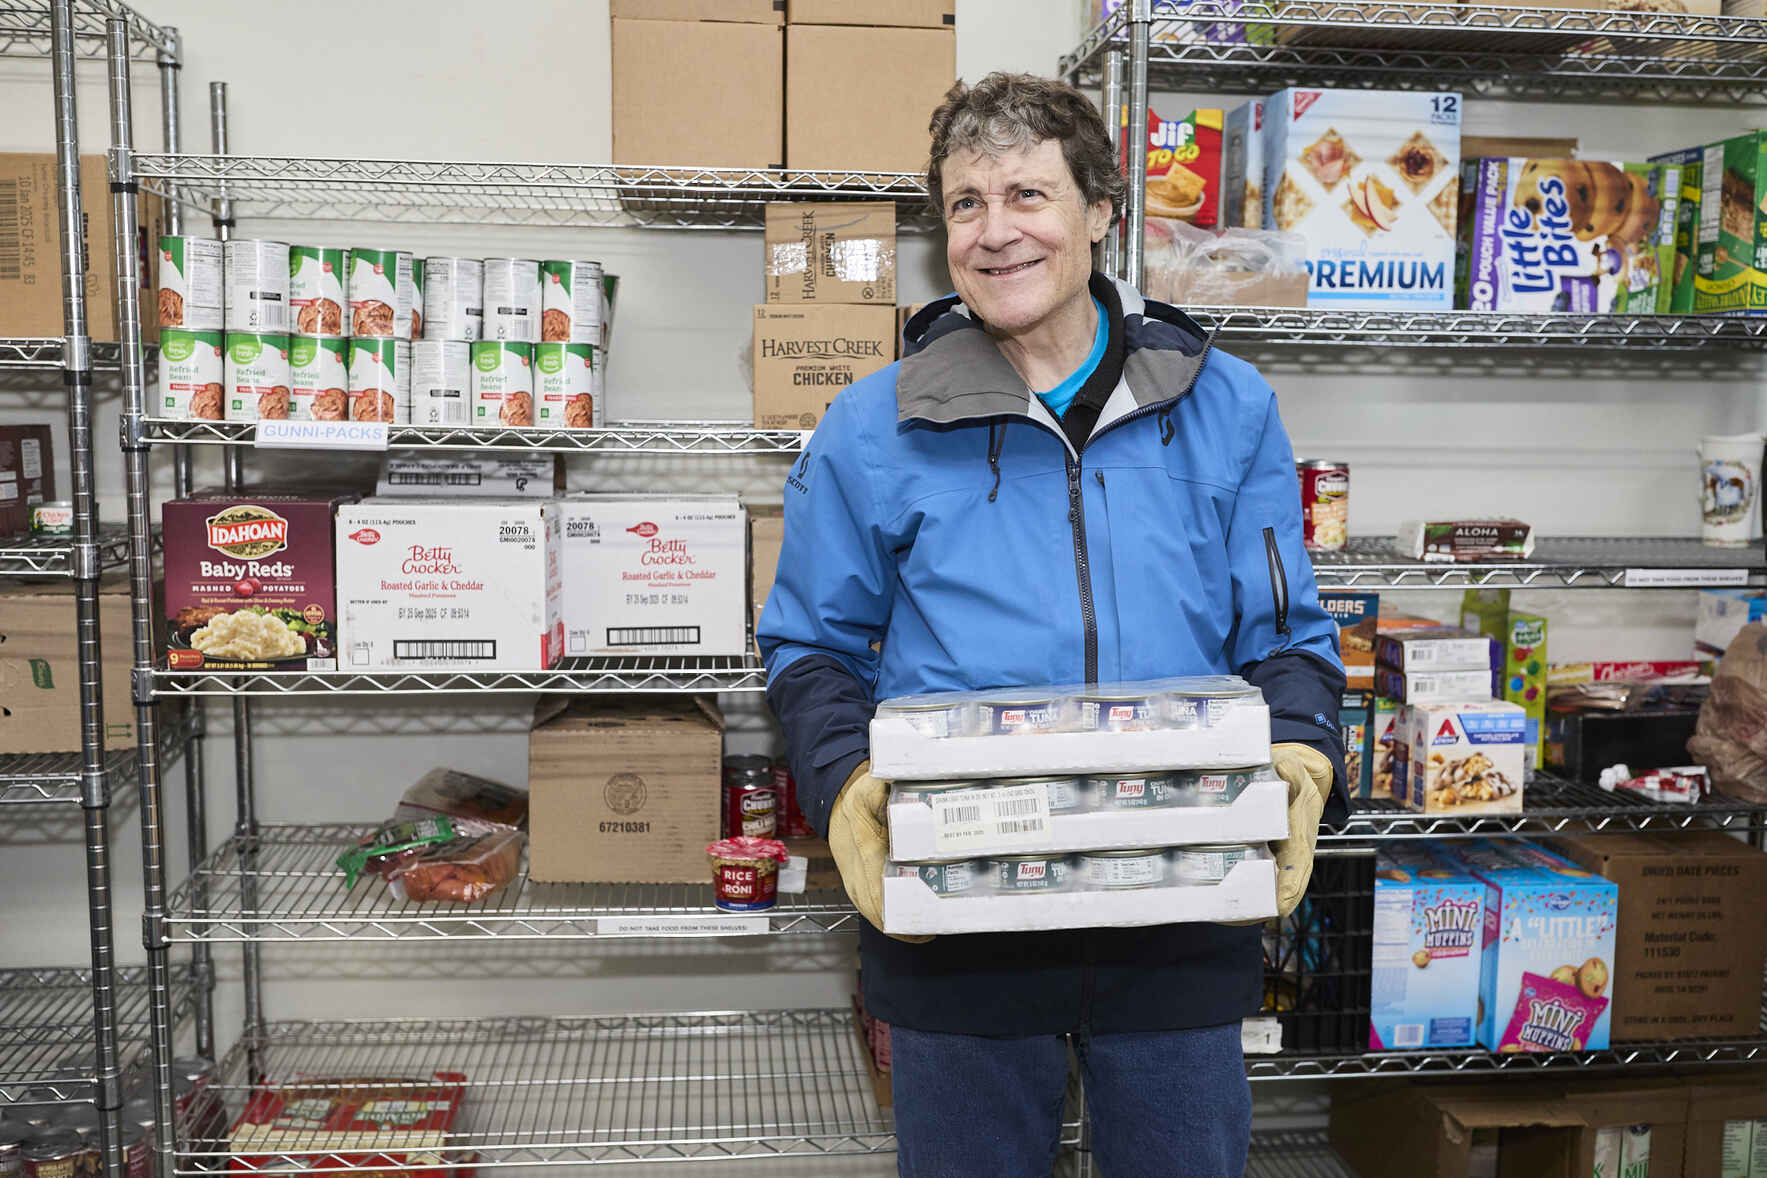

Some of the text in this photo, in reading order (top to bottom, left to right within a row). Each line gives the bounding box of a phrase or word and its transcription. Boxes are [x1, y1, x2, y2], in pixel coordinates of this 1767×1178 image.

[1431, 96, 1457, 113] 12
[1150, 122, 1194, 147] Jif
[1485, 162, 1500, 196] PACK
[20, 205, 33, 227] 2025
[1482, 197, 1496, 235] VALUE
[1540, 178, 1579, 267] Bites
[800, 210, 816, 248] CREEK
[1478, 238, 1493, 281] POUCH
[1503, 210, 1553, 293] Little
[762, 338, 884, 358] HARVEST CREEK
[793, 372, 853, 386] CHICKEN
[264, 424, 383, 440] GUNNI-PACKS
[787, 475, 808, 495] SCOTT
[212, 523, 283, 544] IDAHOAN
[499, 526, 529, 535] 20078
[566, 522, 594, 530] 20078
[1456, 528, 1498, 536] ALOHA
[646, 538, 687, 554] Betty
[408, 545, 452, 564] Betty
[641, 550, 695, 566] Crocker
[200, 561, 293, 581] Baby Reds
[401, 558, 463, 574] Crocker
[622, 570, 716, 581] Roasted Garlic & Cheddar
[381, 580, 484, 591] Roasted Garlic & Cheddar
[1320, 600, 1366, 614] LDERS
[169, 653, 179, 664] 9
[1119, 782, 1144, 794] Tuny
[599, 822, 650, 833] 67210381
[724, 870, 752, 881] RICE
[1020, 864, 1045, 876] Tuny
[1676, 865, 1702, 877] DATE
[1704, 865, 1740, 877] PIECES
[725, 884, 752, 894] RONI
[1425, 901, 1478, 932] MINI
[1511, 918, 1522, 937] A
[1425, 931, 1473, 948] MUFFINS
[1645, 932, 1687, 942] Material
[1532, 1001, 1585, 1035] MINI
[1521, 1026, 1572, 1050] MUFFINS
